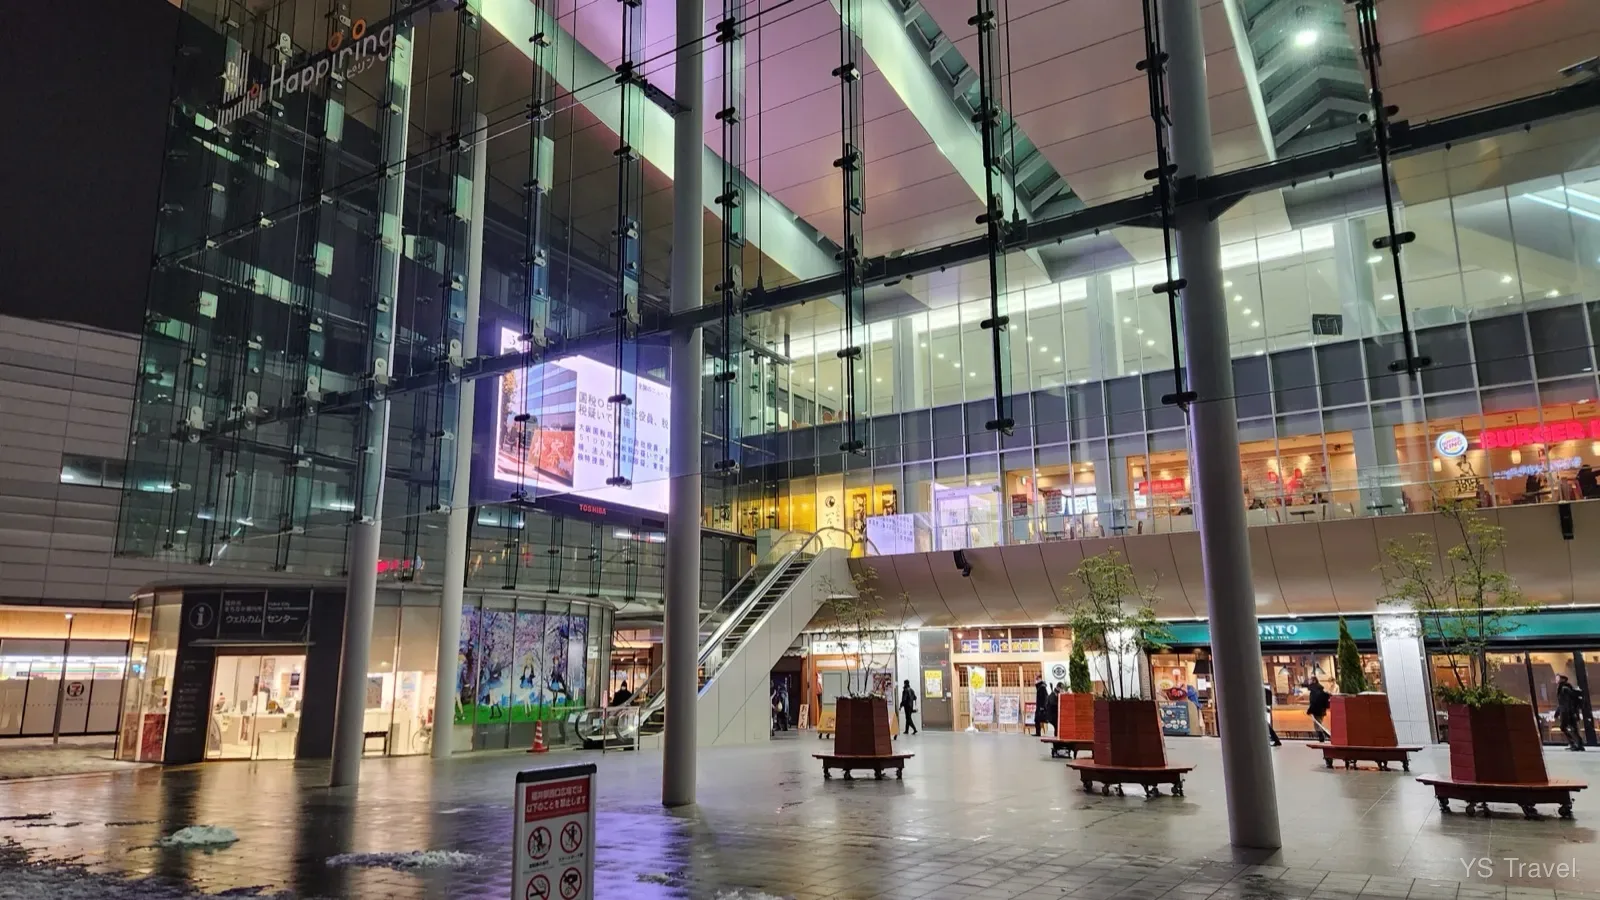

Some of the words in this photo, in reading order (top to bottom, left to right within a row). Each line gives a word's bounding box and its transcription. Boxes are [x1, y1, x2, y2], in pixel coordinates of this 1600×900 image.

[269, 18, 394, 101] Happiring
[1480, 420, 1585, 449] BURGER
[1443, 440, 1463, 451] KING
[579, 503, 607, 516] TOSHIBA
[226, 615, 262, 624] ウェルカム
[267, 614, 299, 623] センター
[1257, 624, 1298, 635] ONTO
